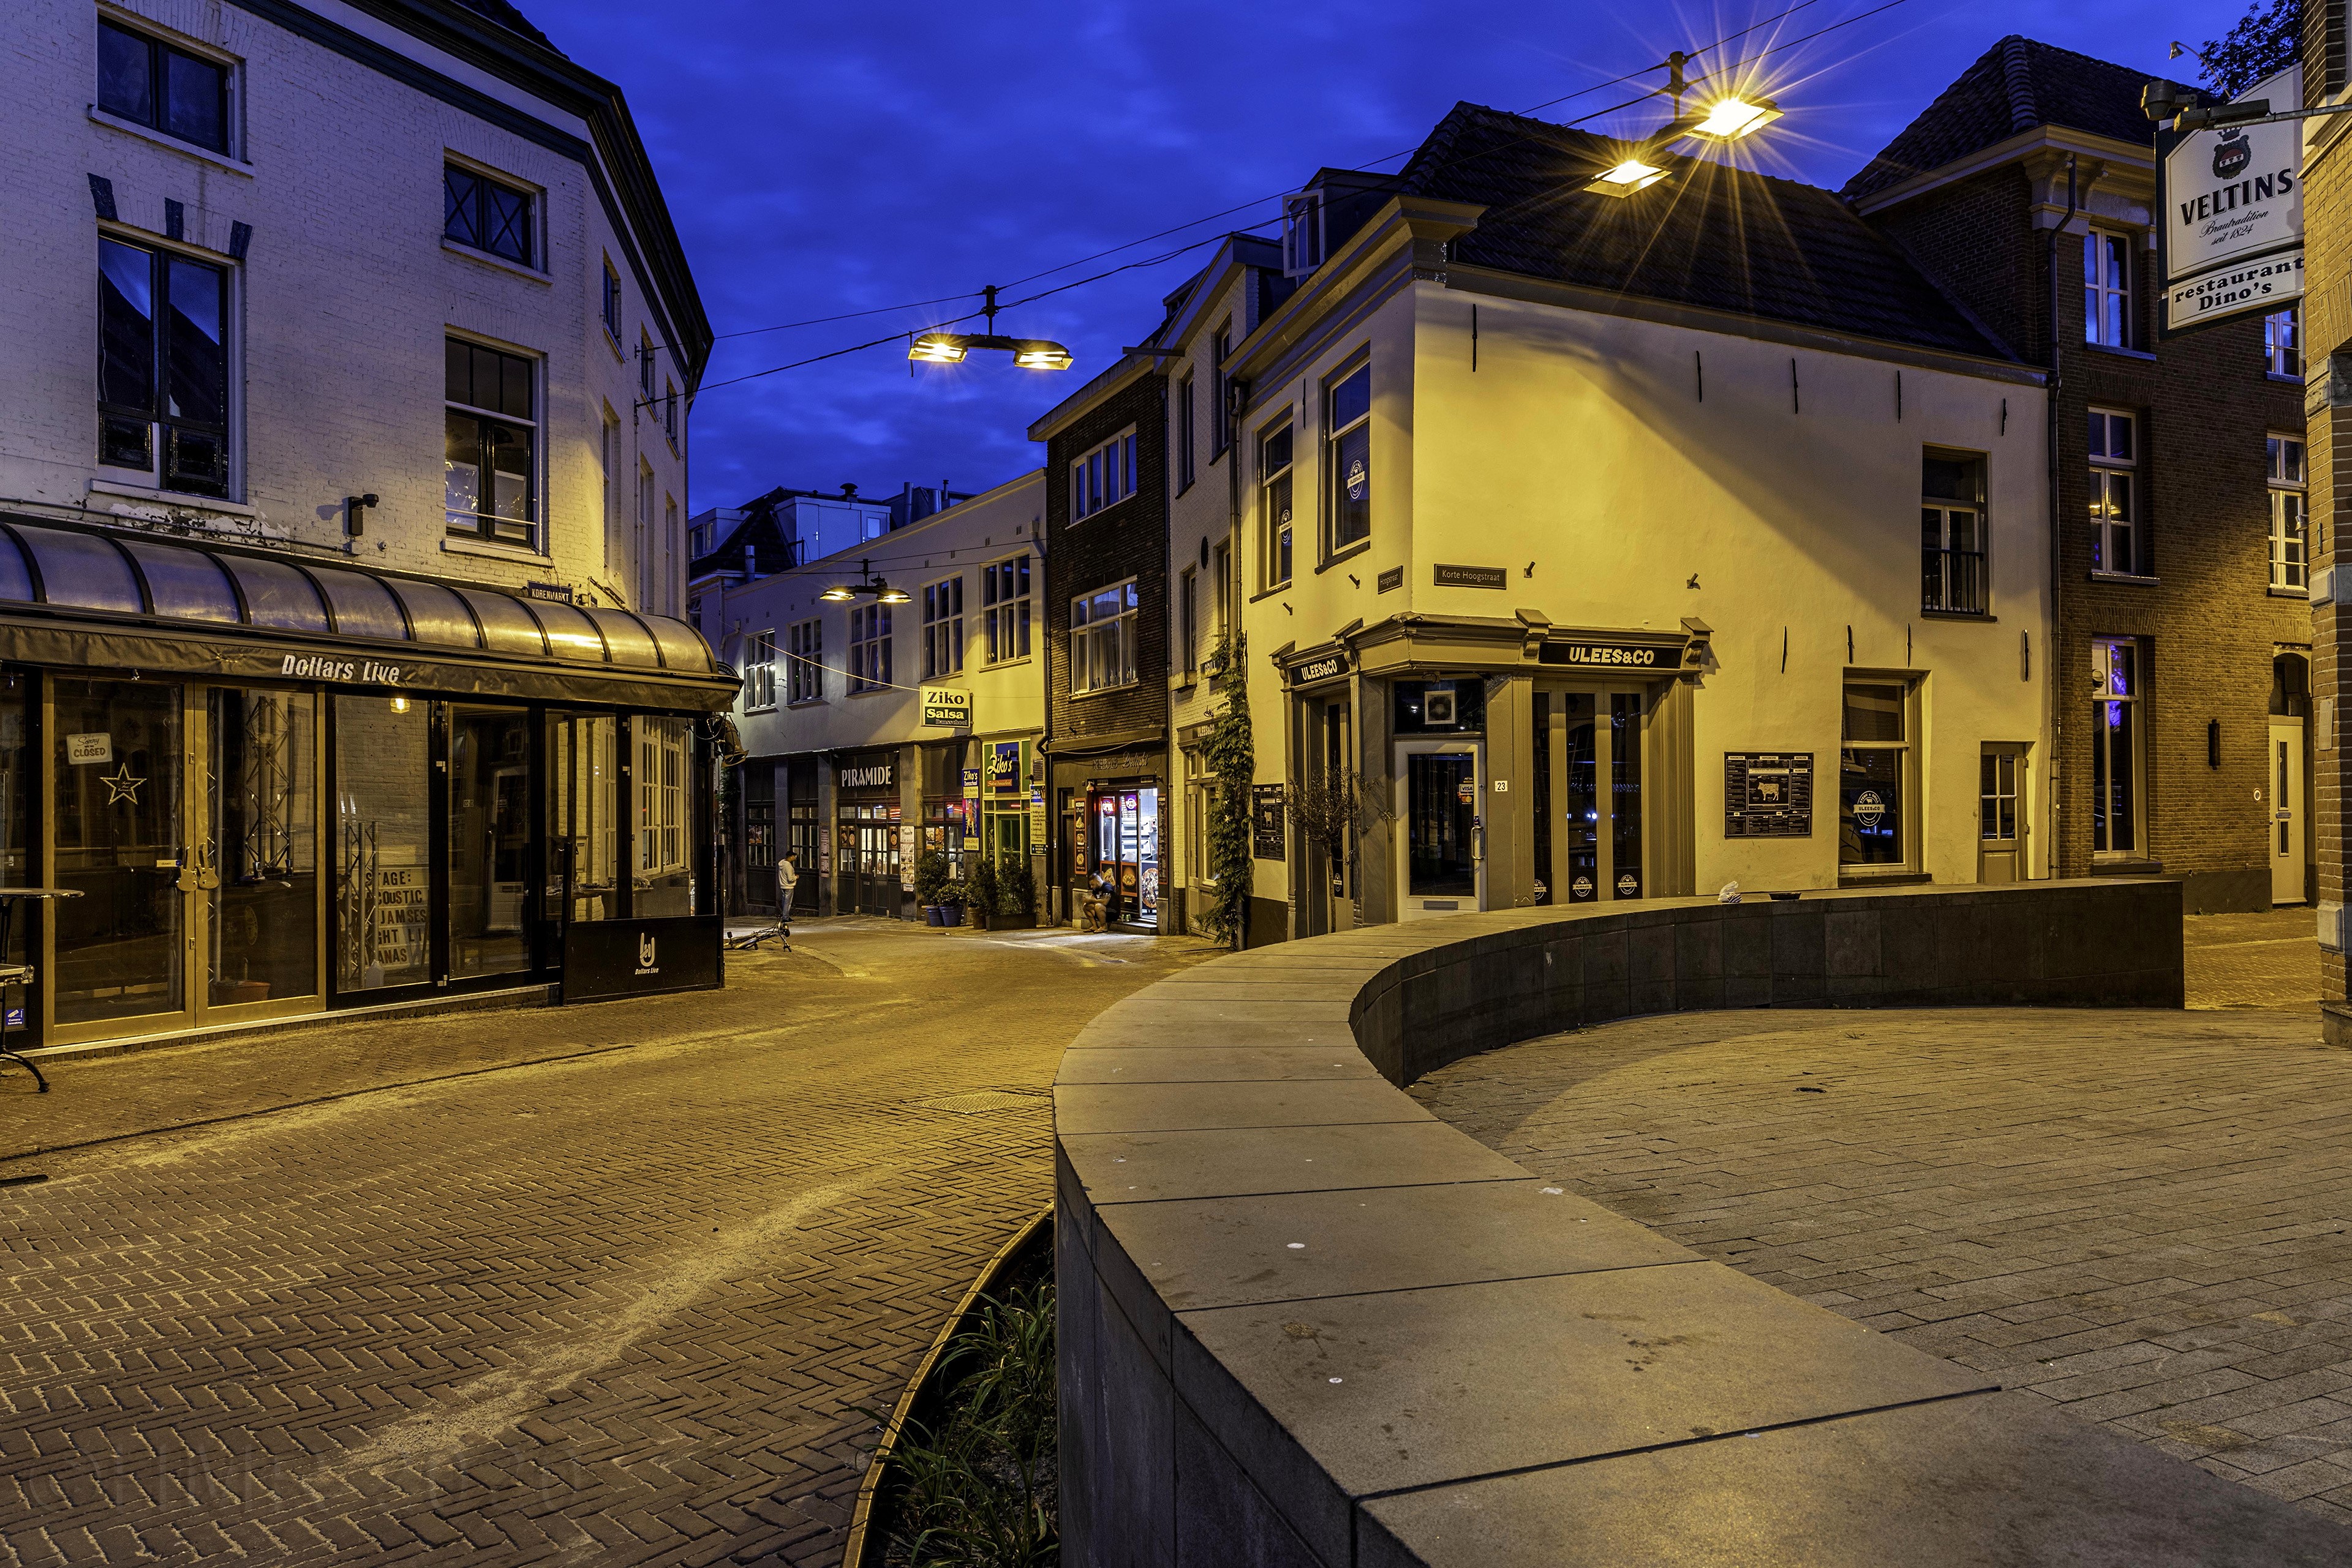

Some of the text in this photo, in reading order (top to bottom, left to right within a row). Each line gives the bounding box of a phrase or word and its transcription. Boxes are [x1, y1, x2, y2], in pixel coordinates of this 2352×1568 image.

[2181, 168, 2294, 227] VELTINS
[2199, 209, 2269, 238] Brautradition
[2211, 224, 2253, 246] seit 1824
[2175, 256, 2304, 303] restaurant
[2199, 281, 2272, 311] Dino's
[1380, 573, 1398, 586] Hoogstraat
[1442, 570, 1500, 582] Korte Hoogstraat
[532, 589, 569, 602] KORENMARKT
[1569, 647, 1654, 665] ULEES&CO
[282, 654, 400, 683] Dollars Live
[1301, 659, 1338, 680] ULEES&CO
[927, 691, 964, 704] Ziko
[927, 708, 964, 719] Salsa
[77, 736, 99, 746] Sorry
[74, 747, 105, 758] CLOSED
[1093, 750, 1149, 774] KEBAB Delight
[842, 766, 891, 787] PIRAMIDE
[964, 771, 978, 781] Ziko's
[1497, 782, 1505, 791] 23
[366, 871, 411, 887] SAGE:
